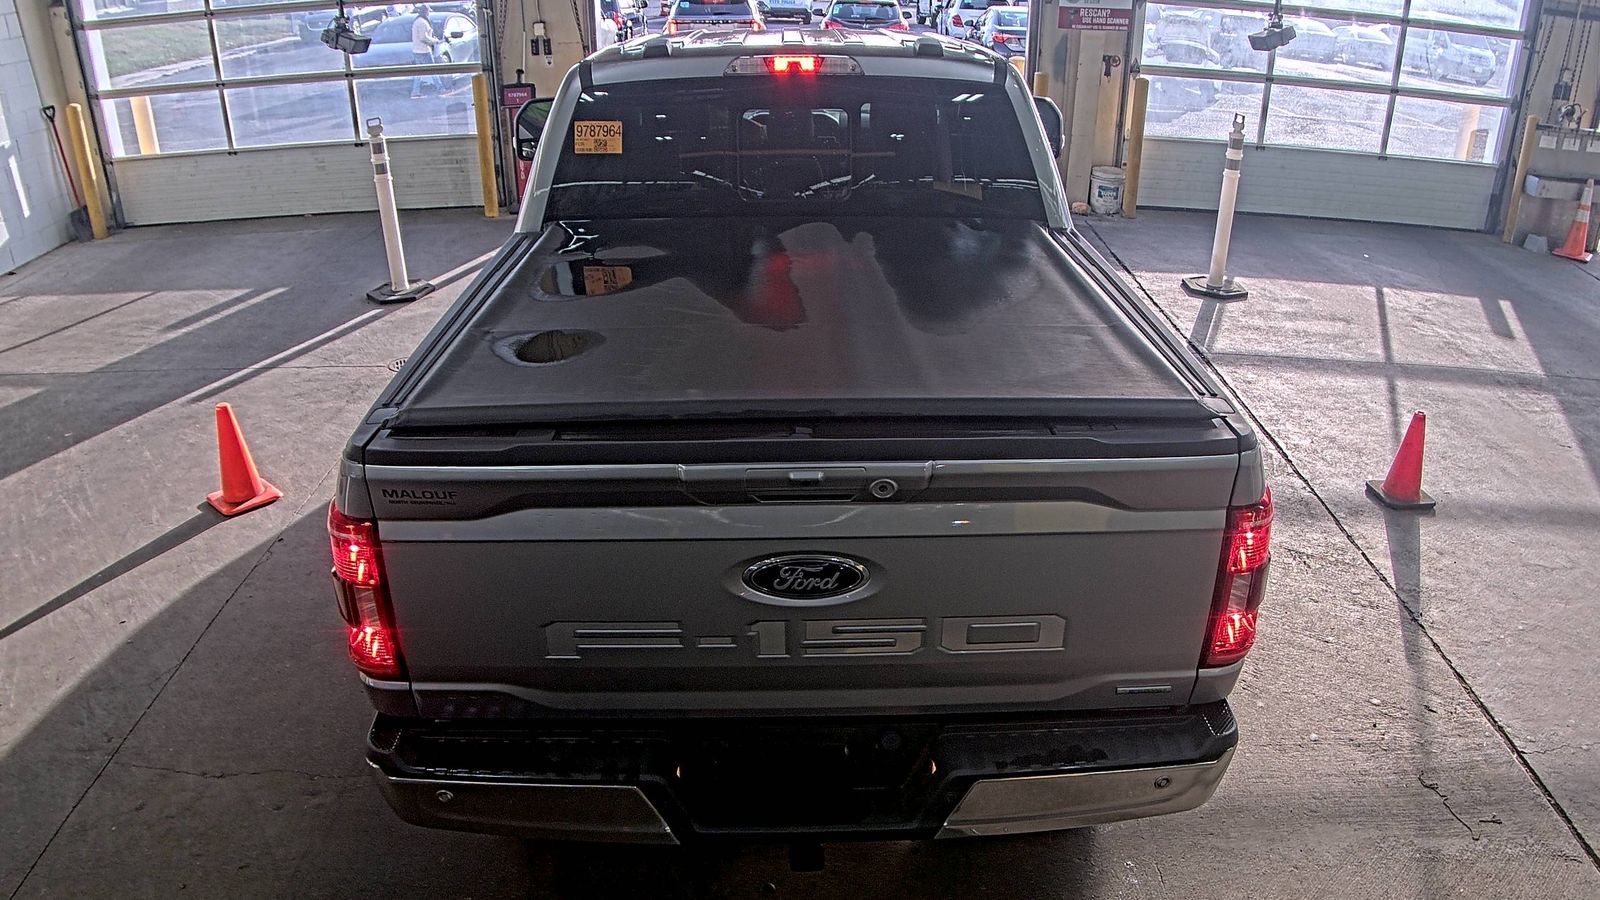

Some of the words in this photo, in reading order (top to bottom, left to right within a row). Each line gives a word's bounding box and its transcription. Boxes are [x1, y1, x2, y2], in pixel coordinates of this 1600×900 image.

[1080, 8, 1111, 17] RESCAN?
[576, 124, 621, 138] 9787964
[381, 489, 458, 500] MALOUF
[773, 563, 841, 591] Ford
[543, 613, 1067, 659] F-150
